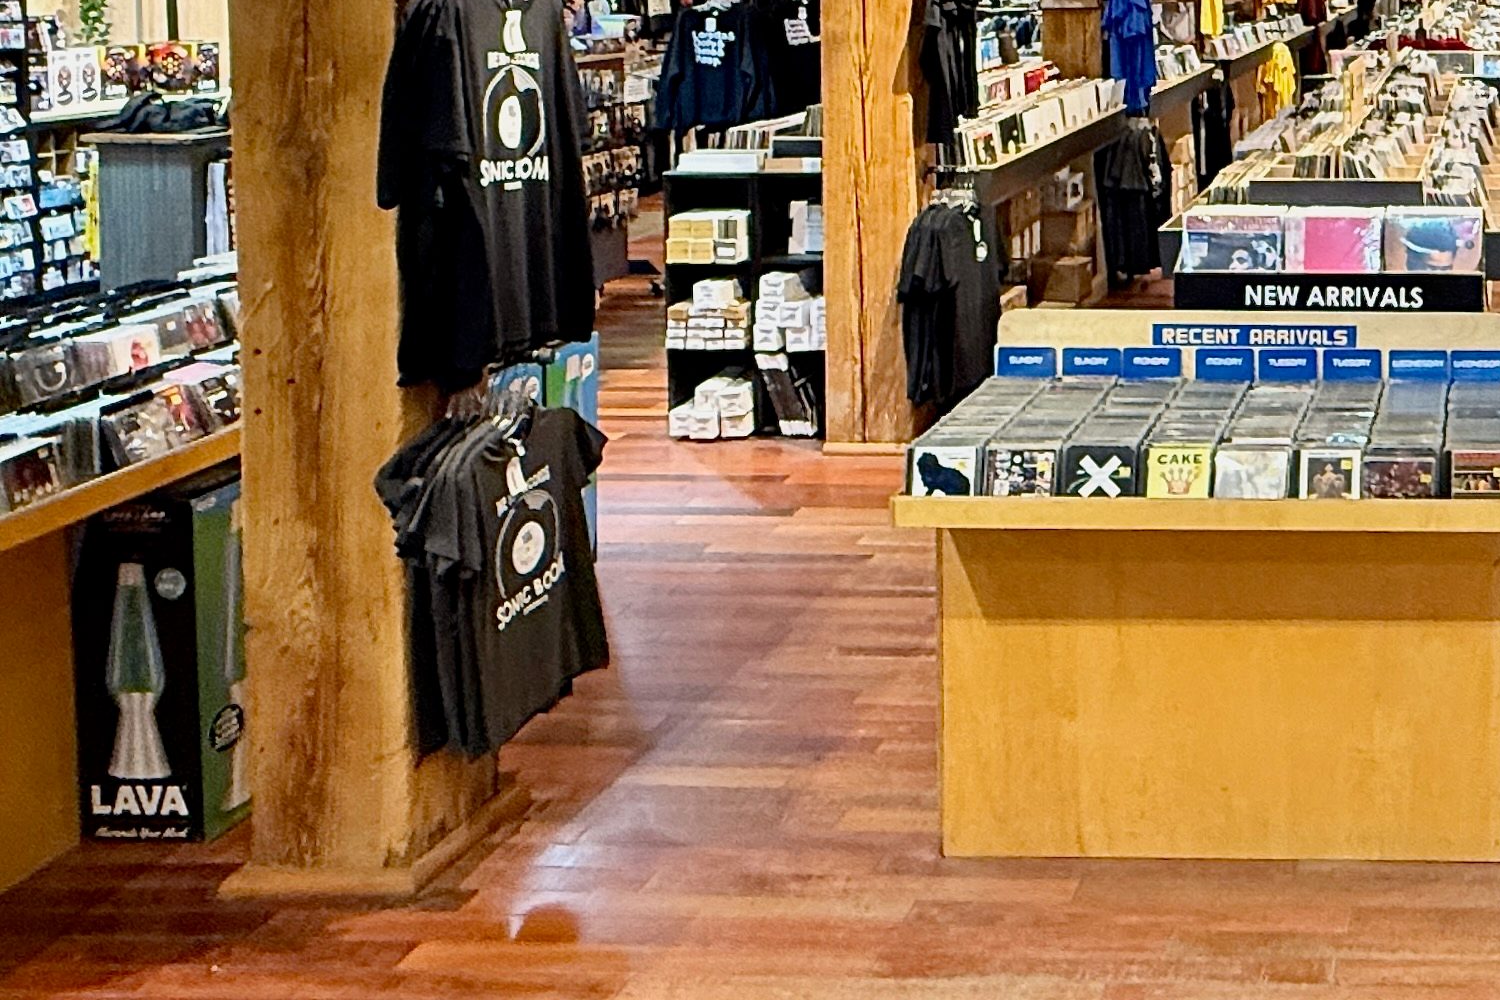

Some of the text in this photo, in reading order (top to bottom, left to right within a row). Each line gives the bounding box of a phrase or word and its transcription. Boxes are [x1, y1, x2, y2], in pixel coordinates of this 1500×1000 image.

[1244, 285, 1424, 309] NEW ARRIVALS
[1161, 327, 1349, 347] RECENT ARRIVALS
[1156, 452, 1203, 465] CAKE
[91, 785, 189, 816] LAVA
